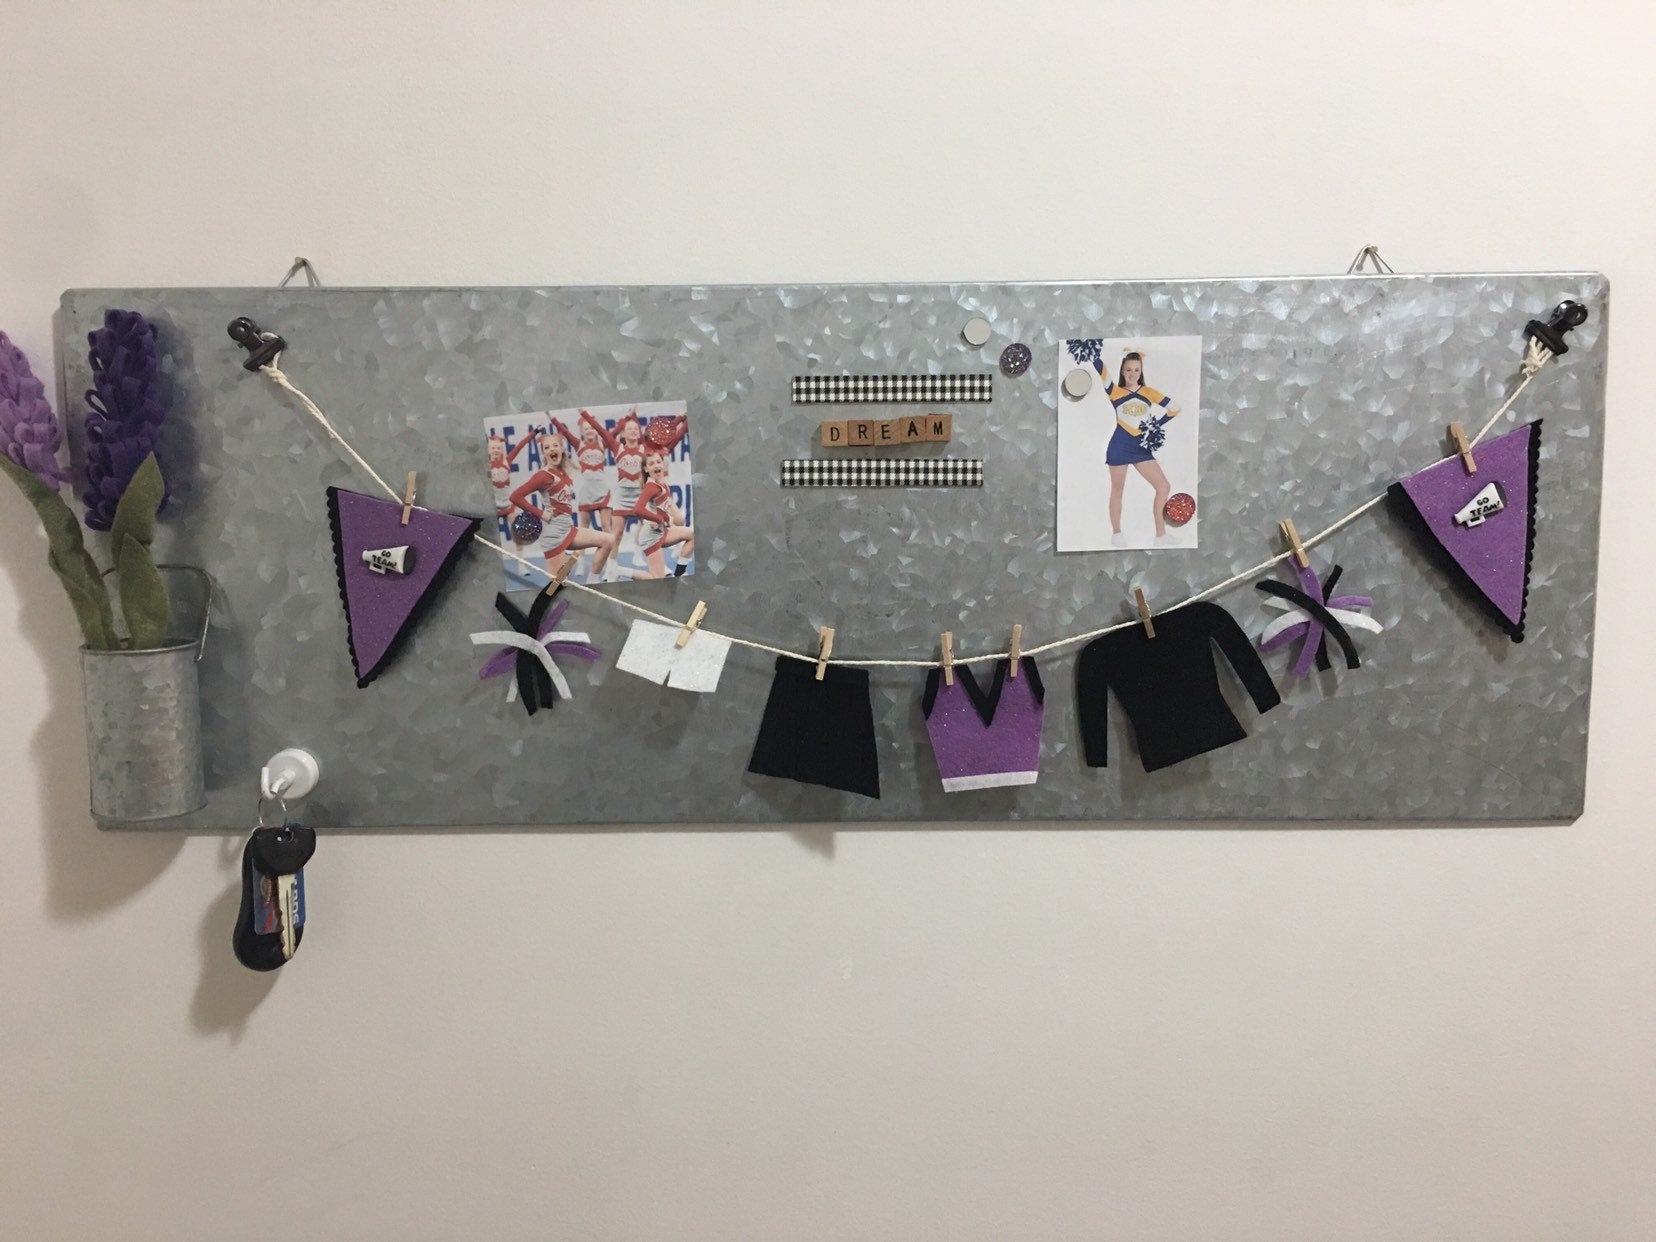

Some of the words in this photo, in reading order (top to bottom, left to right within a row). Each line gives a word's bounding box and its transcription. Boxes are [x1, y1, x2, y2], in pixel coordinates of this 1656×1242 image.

[829, 420, 944, 442] DREAM
[1469, 500, 1500, 517] TEAM!
[1476, 496, 1490, 506] GO
[372, 554, 398, 569] TEAM!
[381, 550, 392, 558] GO
